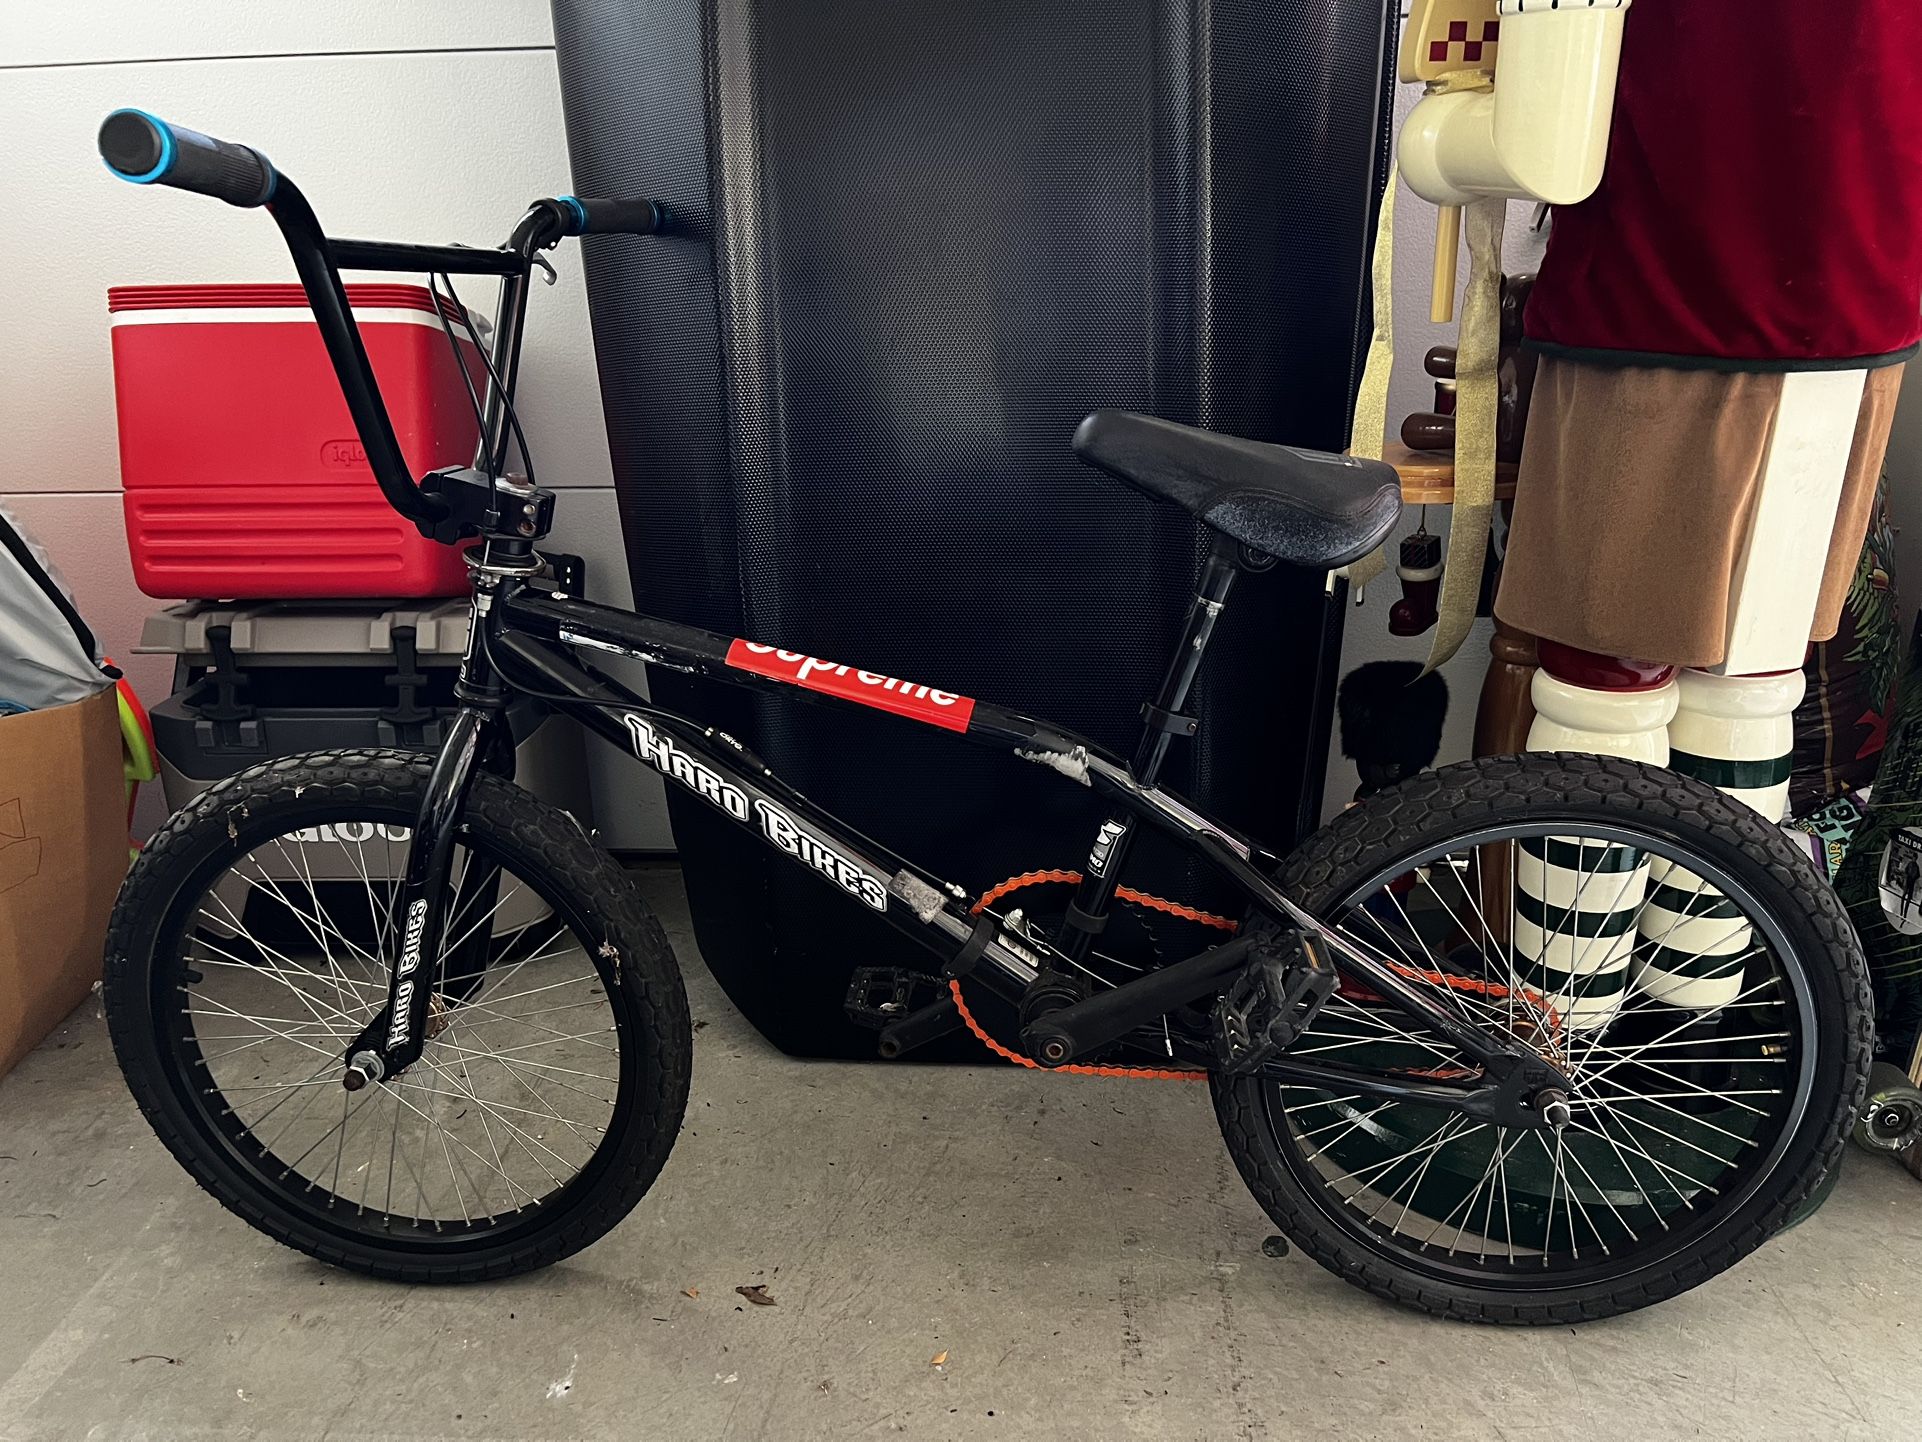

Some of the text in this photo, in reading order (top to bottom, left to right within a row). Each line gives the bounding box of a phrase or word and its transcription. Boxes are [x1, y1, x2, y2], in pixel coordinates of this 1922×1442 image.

[624, 713, 887, 912] HARO BIKES
[1898, 834, 1912, 846] TAXI
[386, 899, 428, 1050] HARO BIKES
